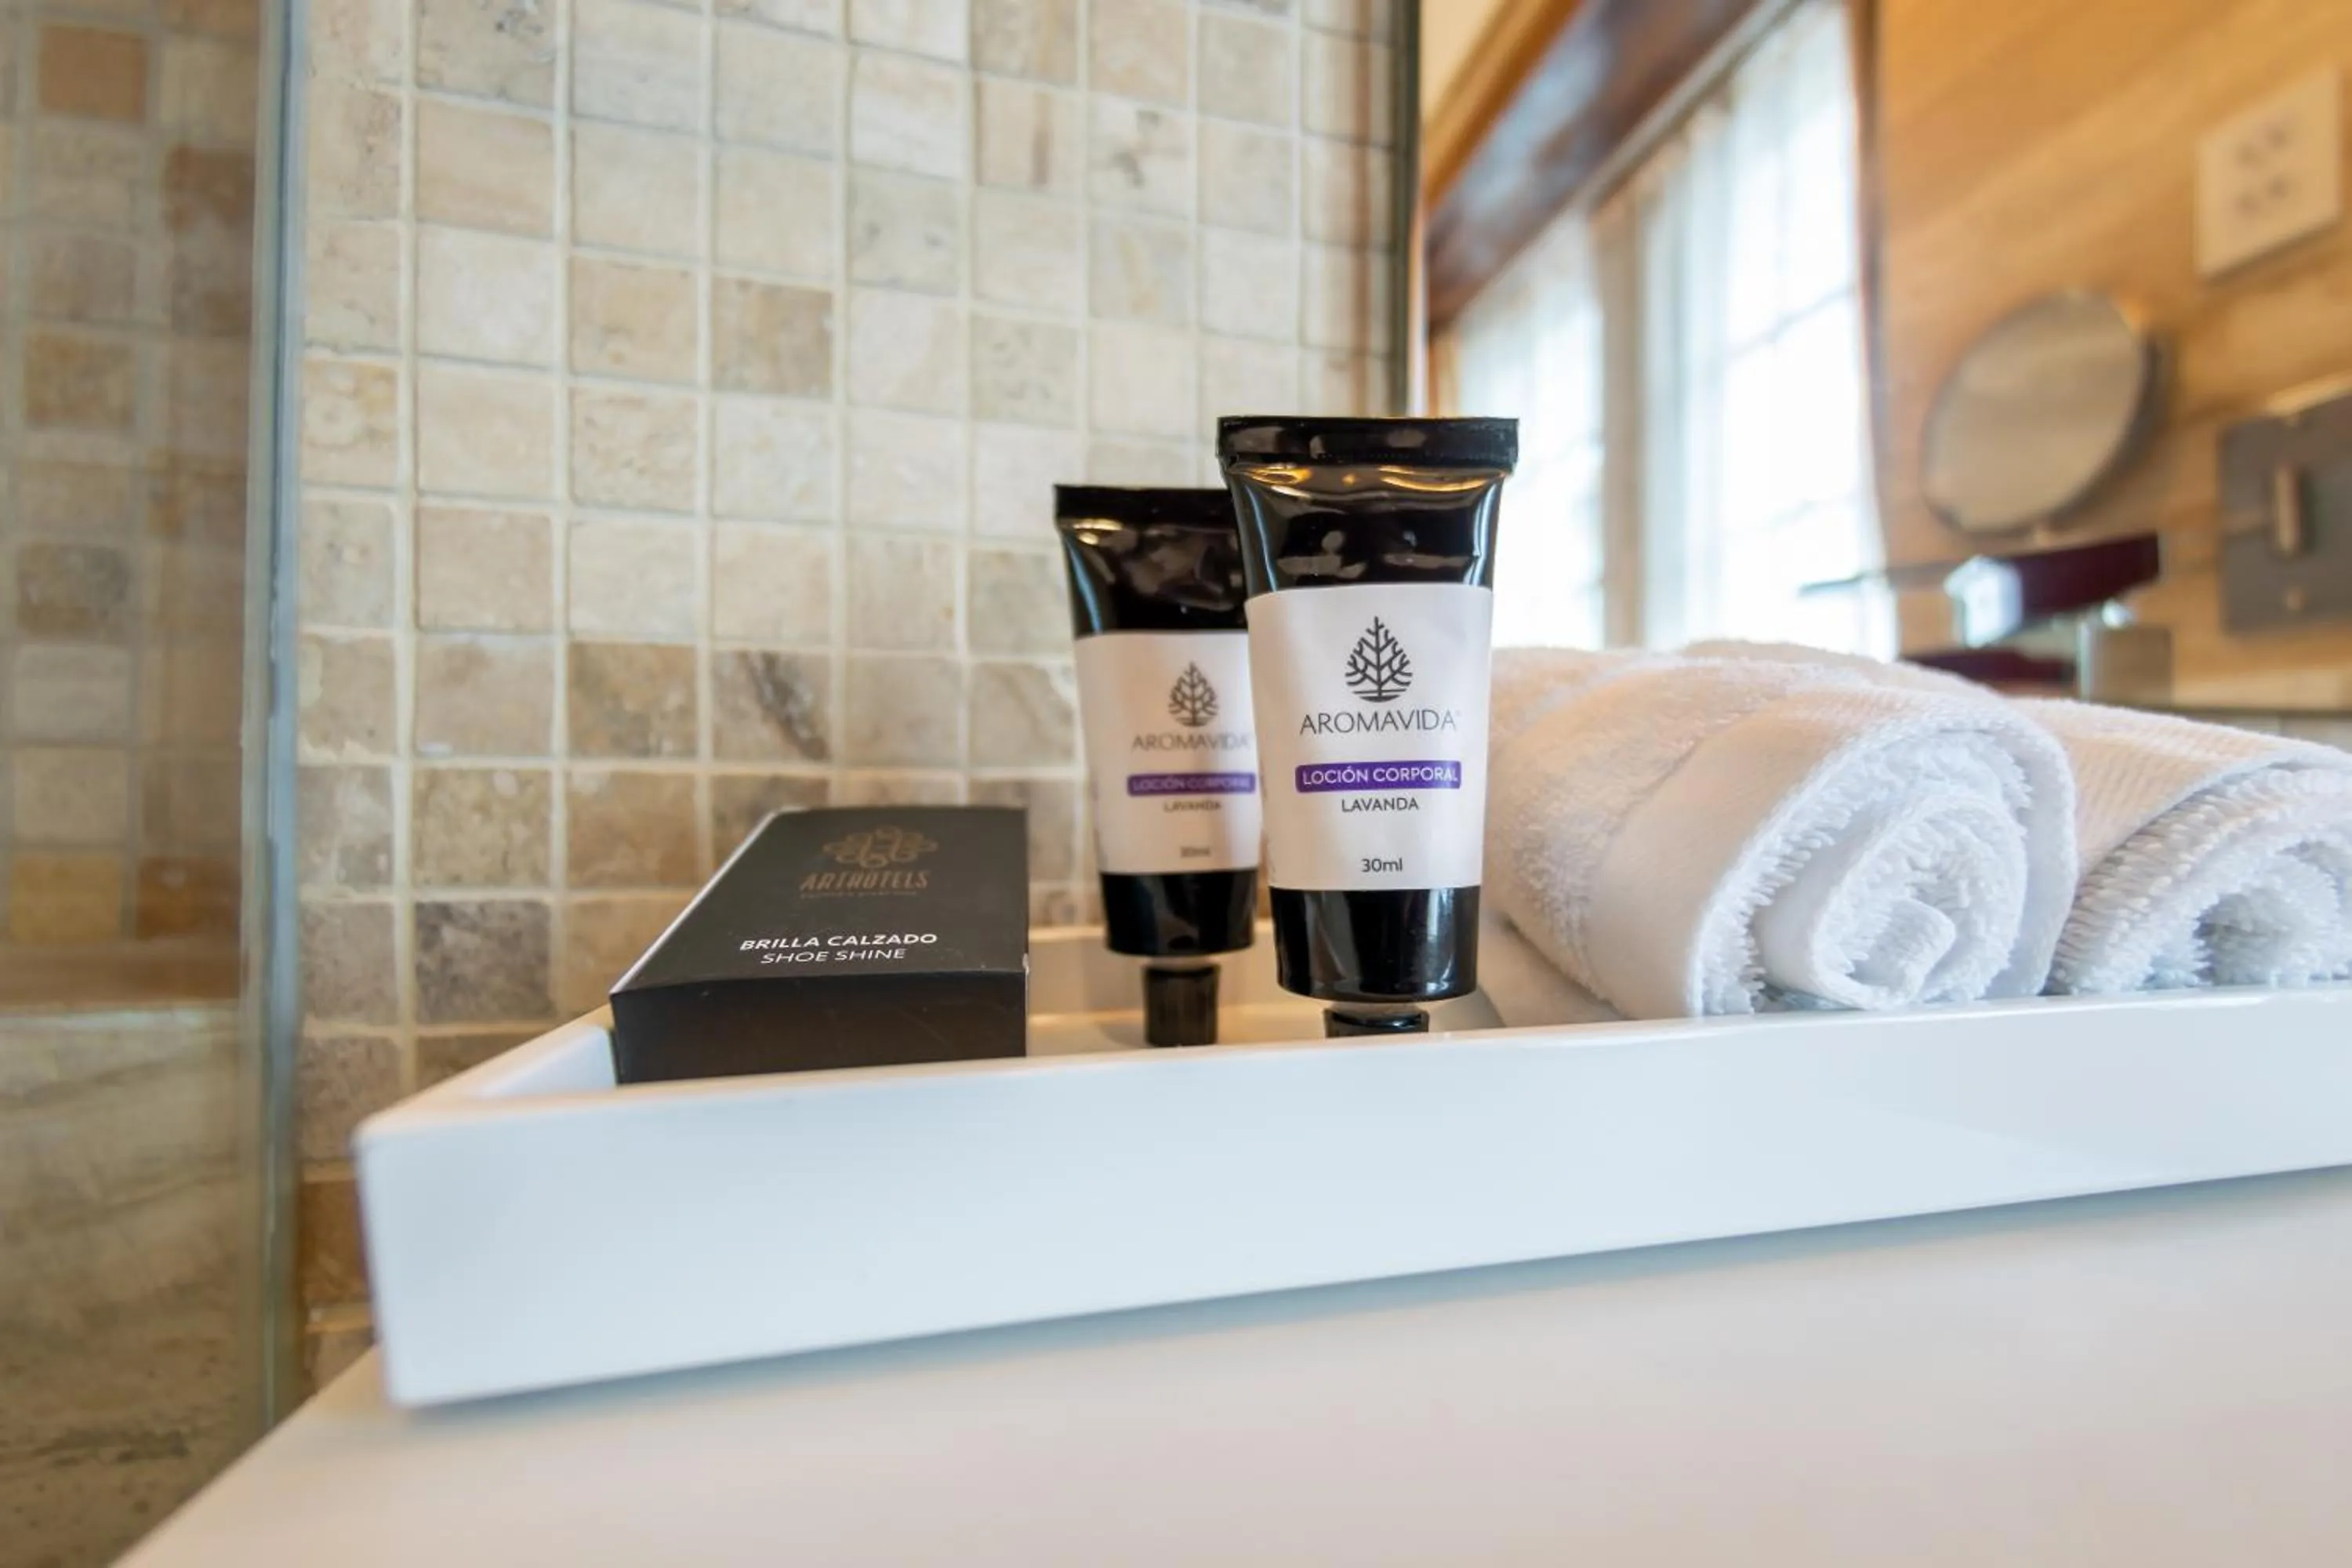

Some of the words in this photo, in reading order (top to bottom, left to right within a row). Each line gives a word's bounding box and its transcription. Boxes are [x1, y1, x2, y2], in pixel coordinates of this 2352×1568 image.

[1299, 710, 1457, 735] AROMAVIDA
[1302, 765, 1369, 785] LOCIÓN
[1372, 767, 1458, 783] CORPORAL
[1341, 797, 1420, 812] LAVANDA
[1361, 858, 1403, 873] 30ml
[799, 870, 929, 891] ARTHOTELS
[739, 938, 821, 951] BRILLA
[826, 934, 938, 947] CALZADO
[760, 951, 829, 964] SHOE
[834, 947, 906, 961] SHINE
